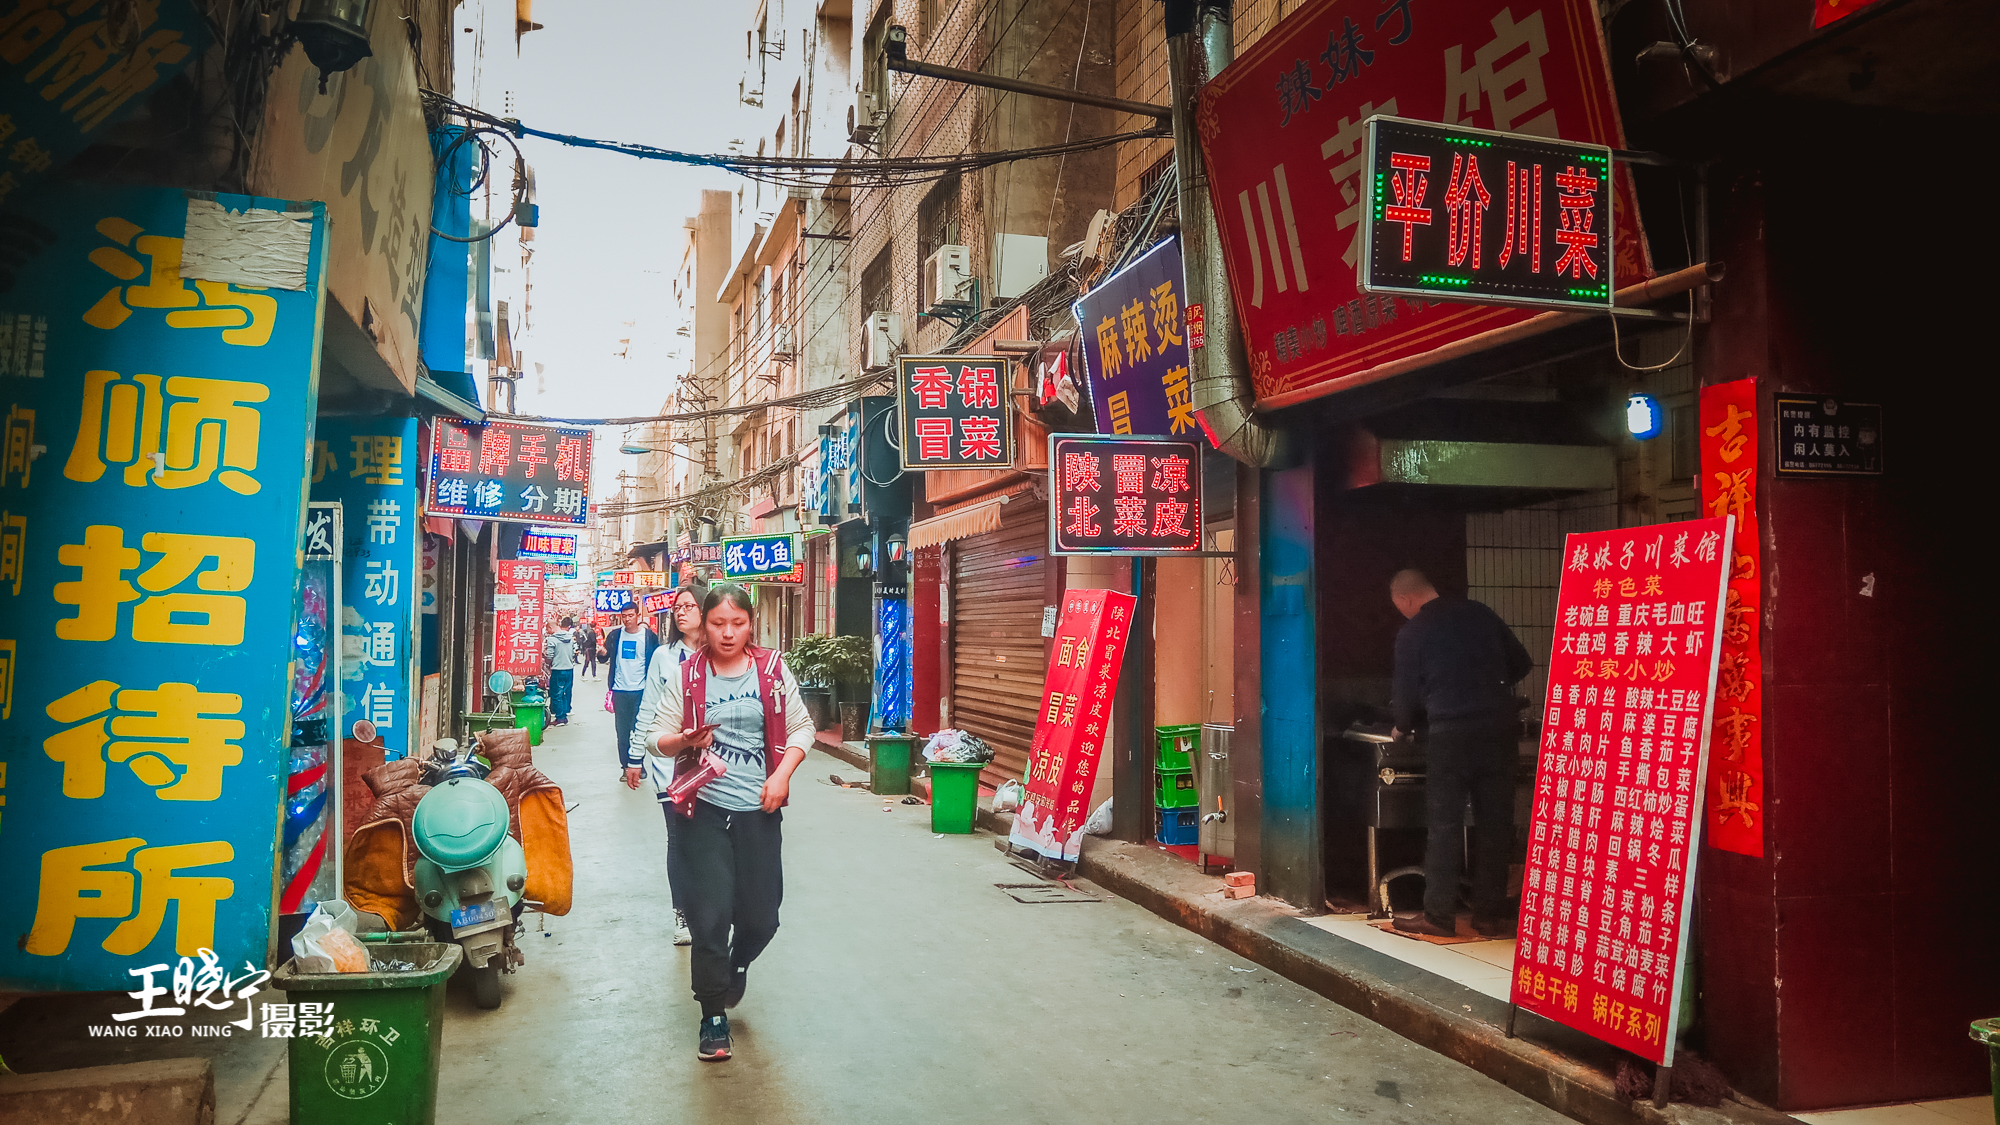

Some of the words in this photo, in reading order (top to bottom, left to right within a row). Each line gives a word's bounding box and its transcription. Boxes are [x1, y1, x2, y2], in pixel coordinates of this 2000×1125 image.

[1275, 0, 1413, 128] 辣妹子
[1386, 152, 1598, 279] 平价川菜
[1096, 280, 1182, 380] 麻辣烫
[1273, 313, 1327, 364] 精美小炒
[911, 365, 999, 409] 香锅
[915, 416, 1002, 461] 冒菜
[1794, 423, 1850, 439] 内有监控
[1794, 443, 1850, 456] 闲人莫入
[440, 428, 584, 482] 品牌手机
[438, 477, 504, 508] 维修
[519, 484, 583, 516] 分期
[1065, 452, 1102, 537] 陕北
[1113, 454, 1147, 537] 冒菜
[1151, 454, 1190, 538] 凉皮
[525, 536, 574, 554] 川味冒菜
[727, 541, 791, 573] 纸包鱼
[1568, 530, 1720, 573] 辣妹子川菜馆
[1593, 574, 1663, 599] 特色菜
[508, 565, 543, 664] 新吉祥招待所
[1564, 603, 1609, 627] 老碗鱼
[1616, 601, 1706, 626] 重庆毛血旺
[1057, 636, 1090, 670] 面食
[1560, 631, 1606, 655] 大盘鸡
[1614, 630, 1704, 656] 香辣大虾
[1573, 657, 1676, 682] 农家小炒
[1046, 691, 1078, 728] 冒菜
[1062, 605, 1125, 835] 陕北冒菜凉皮欢迎您的品尝
[1551, 683, 1616, 707] 鱼香肉丝
[1625, 686, 1700, 712] 酸辣土豆丝
[1548, 707, 1613, 732] 回锅肉
[1622, 711, 1698, 740] 麻婆豆腐
[1032, 748, 1064, 787] 凉皮
[1545, 729, 1610, 756] 水煮肉片
[1619, 736, 1694, 765] 鱼香茄子
[1543, 752, 1607, 780] 农家小炒肉
[1617, 761, 1691, 792] 手撕包菜
[1540, 774, 1604, 805] 尖椒肥肠
[1614, 785, 1689, 819] 西红柿炒蛋
[1537, 798, 1601, 829] 火爆猪肝
[1610, 810, 1686, 845] 麻辣烩菜
[1534, 821, 1599, 854] 西芹腊肉
[1608, 835, 1681, 872] 回锅冬瓜
[1531, 844, 1595, 879] 红烧鱼块
[1605, 859, 1680, 899] 素三样
[1528, 867, 1593, 904] 糖醋里脊
[1601, 884, 1675, 926] 泡菜粉条
[1526, 890, 1590, 929] 红烧带鱼
[1598, 909, 1673, 951] 豆角茄子
[1523, 914, 1587, 953] 红烧排骨
[1596, 934, 1671, 980] 蒜茸油麦菜
[1520, 937, 1585, 978] 泡椒鸡胗
[1593, 959, 1667, 1006] 红烧腐竹
[1517, 965, 1579, 1014] 特色干锅
[1592, 991, 1661, 1046] 锅仔系列
[315, 1018, 401, 1050] 吉祥环卫
